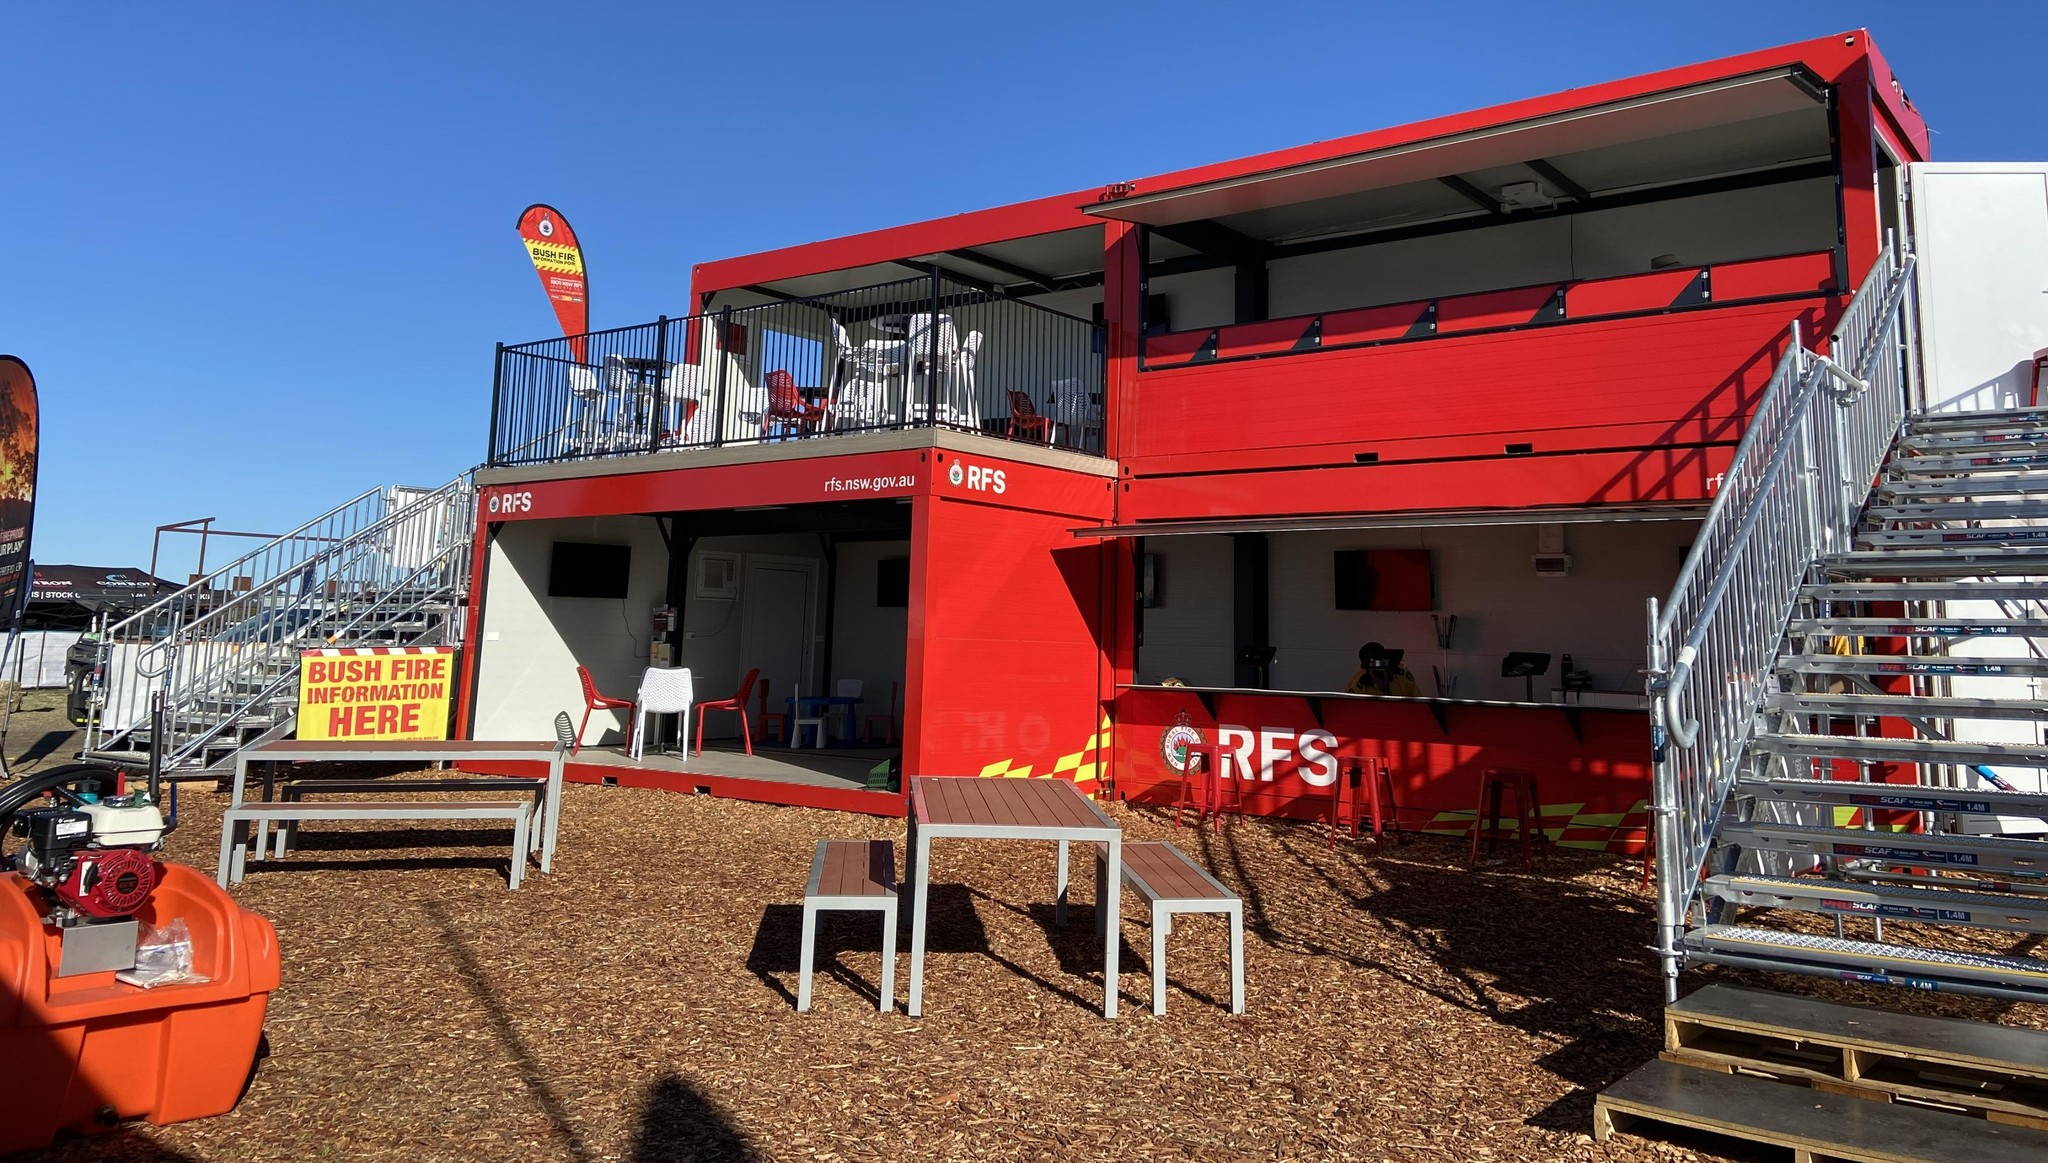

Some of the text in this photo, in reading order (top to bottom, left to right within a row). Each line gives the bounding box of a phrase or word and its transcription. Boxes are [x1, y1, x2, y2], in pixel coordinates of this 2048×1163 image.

[532, 247, 576, 263] BUSH FIRE
[533, 256, 564, 265] INFORMATION
[824, 475, 915, 492] rfs.nsw.gov.au
[967, 465, 1006, 494] RFS
[501, 492, 532, 513] RFS
[45, 591, 73, 599] STOCK
[308, 658, 446, 684] BUSH FIRE
[307, 683, 443, 705] INFORMATION
[328, 703, 421, 738] HERE
[1218, 723, 1339, 787] RFS
[1966, 802, 1986, 812] 1.4M
[1953, 853, 1973, 863] 1.4M
[1945, 911, 1966, 920] 1.4M
[1911, 980, 1934, 991] 1.4M
